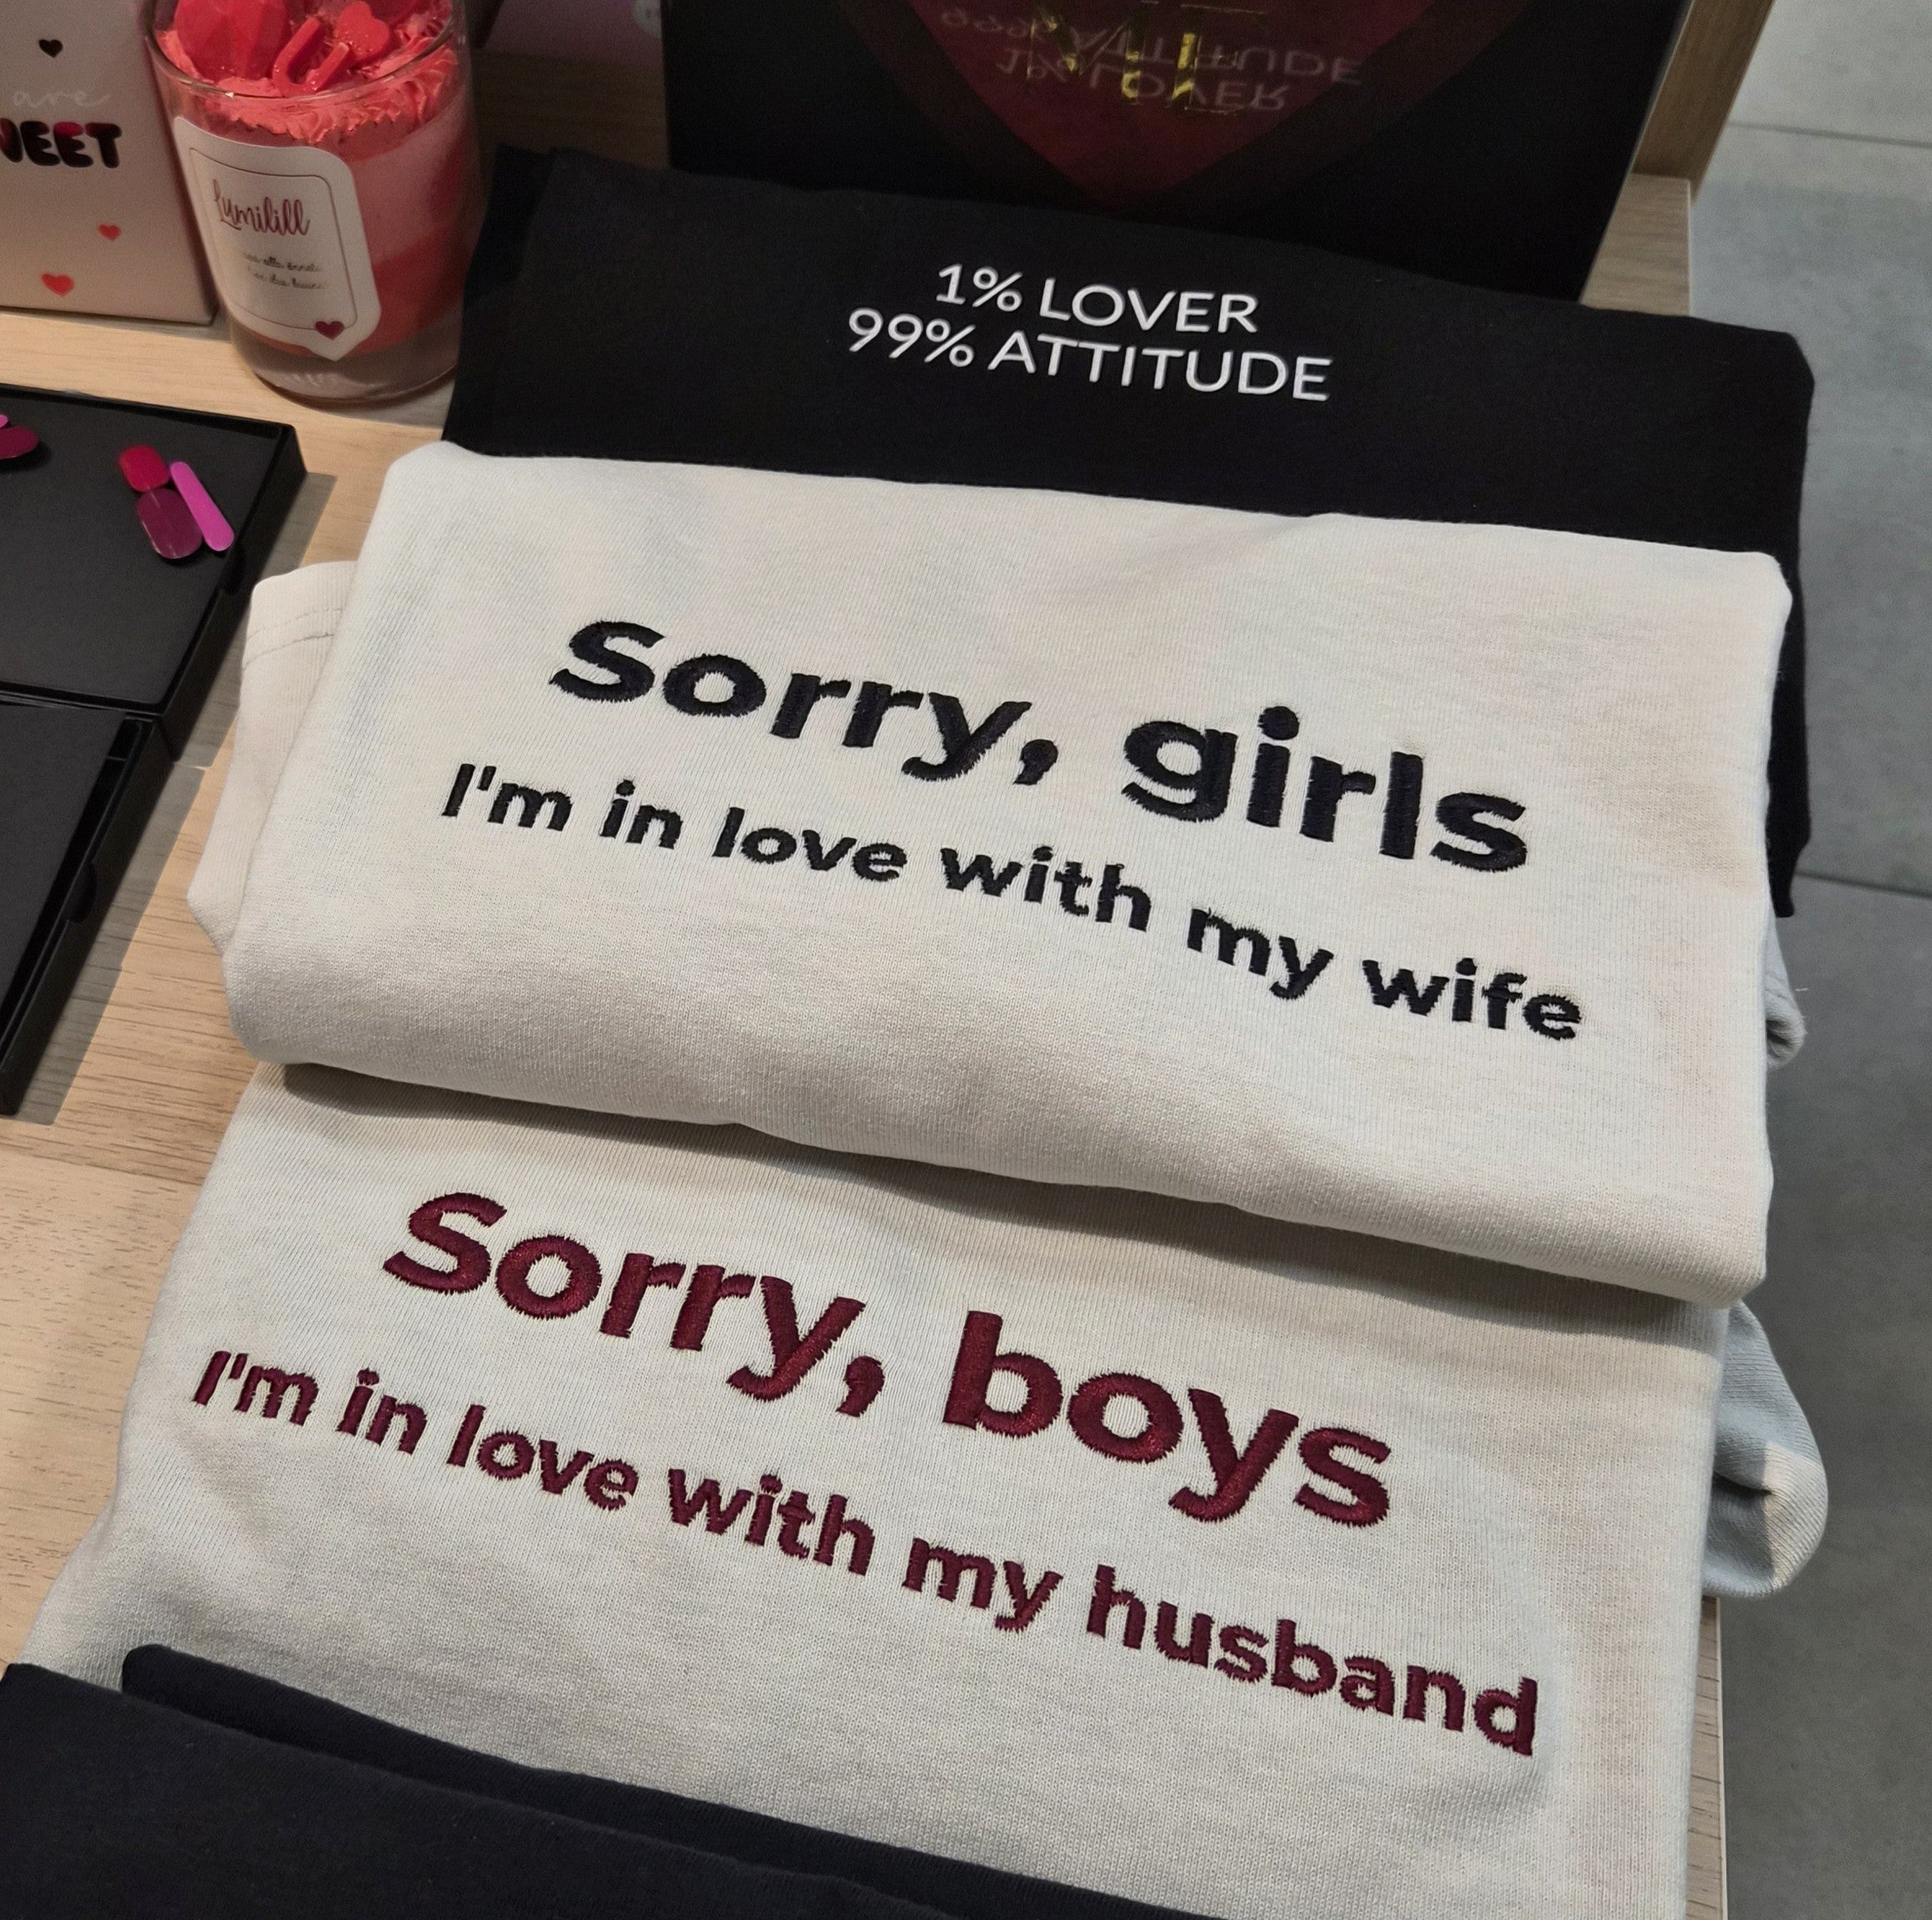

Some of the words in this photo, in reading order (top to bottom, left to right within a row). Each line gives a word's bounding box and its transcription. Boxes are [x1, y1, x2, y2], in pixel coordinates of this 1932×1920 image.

[849, 307, 975, 367] 99%
[988, 331, 1332, 401] ATTITUDE
[936, 264, 1023, 312] 1%
[1039, 277, 1258, 333] LOVER
[548, 620, 1059, 786] Sorry,
[1121, 706, 1530, 875] girls
[441, 763, 573, 832] I'm
[600, 779, 684, 850] in
[711, 806, 908, 882] love
[939, 845, 1153, 932] with
[1187, 907, 1335, 1000] my
[1362, 957, 1583, 1041] wife
[381, 1191, 886, 1418] Sorry,
[942, 1310, 1392, 1530] boys
[191, 1350, 320, 1427] I'm
[335, 1367, 428, 1456] in
[446, 1404, 640, 1512] love
[667, 1468, 877, 1577] with
[901, 1537, 1064, 1634] my
[1086, 1563, 1539, 1757] husband
